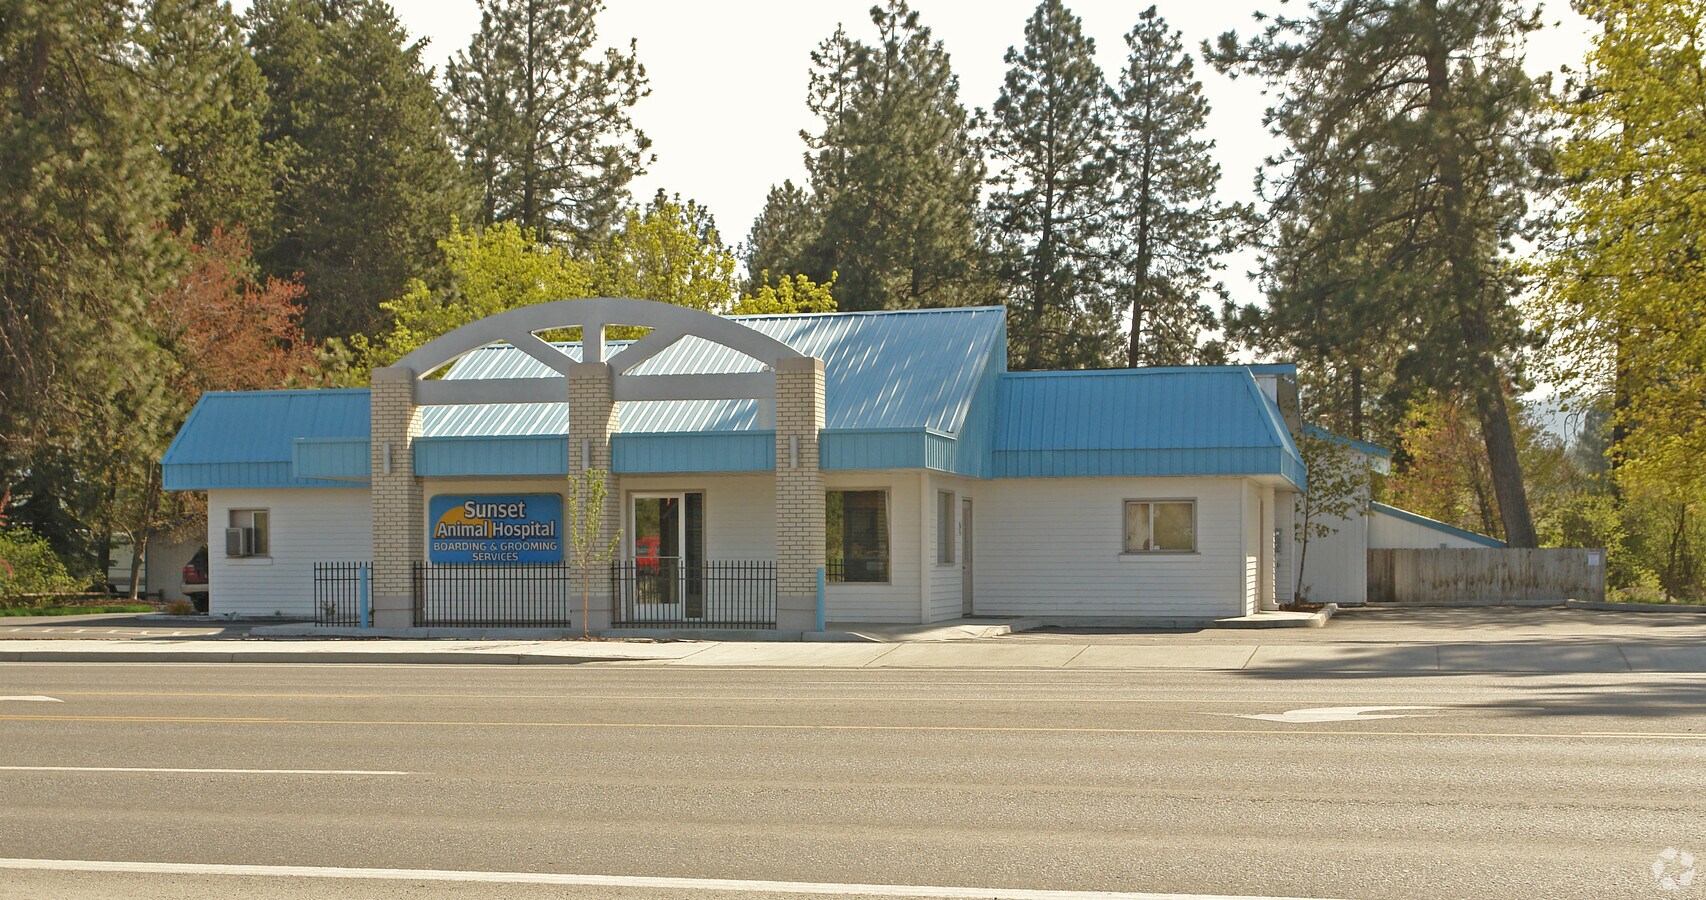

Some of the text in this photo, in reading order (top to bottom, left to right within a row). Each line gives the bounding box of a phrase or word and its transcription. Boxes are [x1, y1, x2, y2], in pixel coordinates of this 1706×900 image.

[464, 500, 526, 519] Sunset
[437, 520, 556, 540] Animal Hospital
[433, 541, 558, 551] BOARDING & GROOMING
[472, 552, 519, 561] SERVICES
